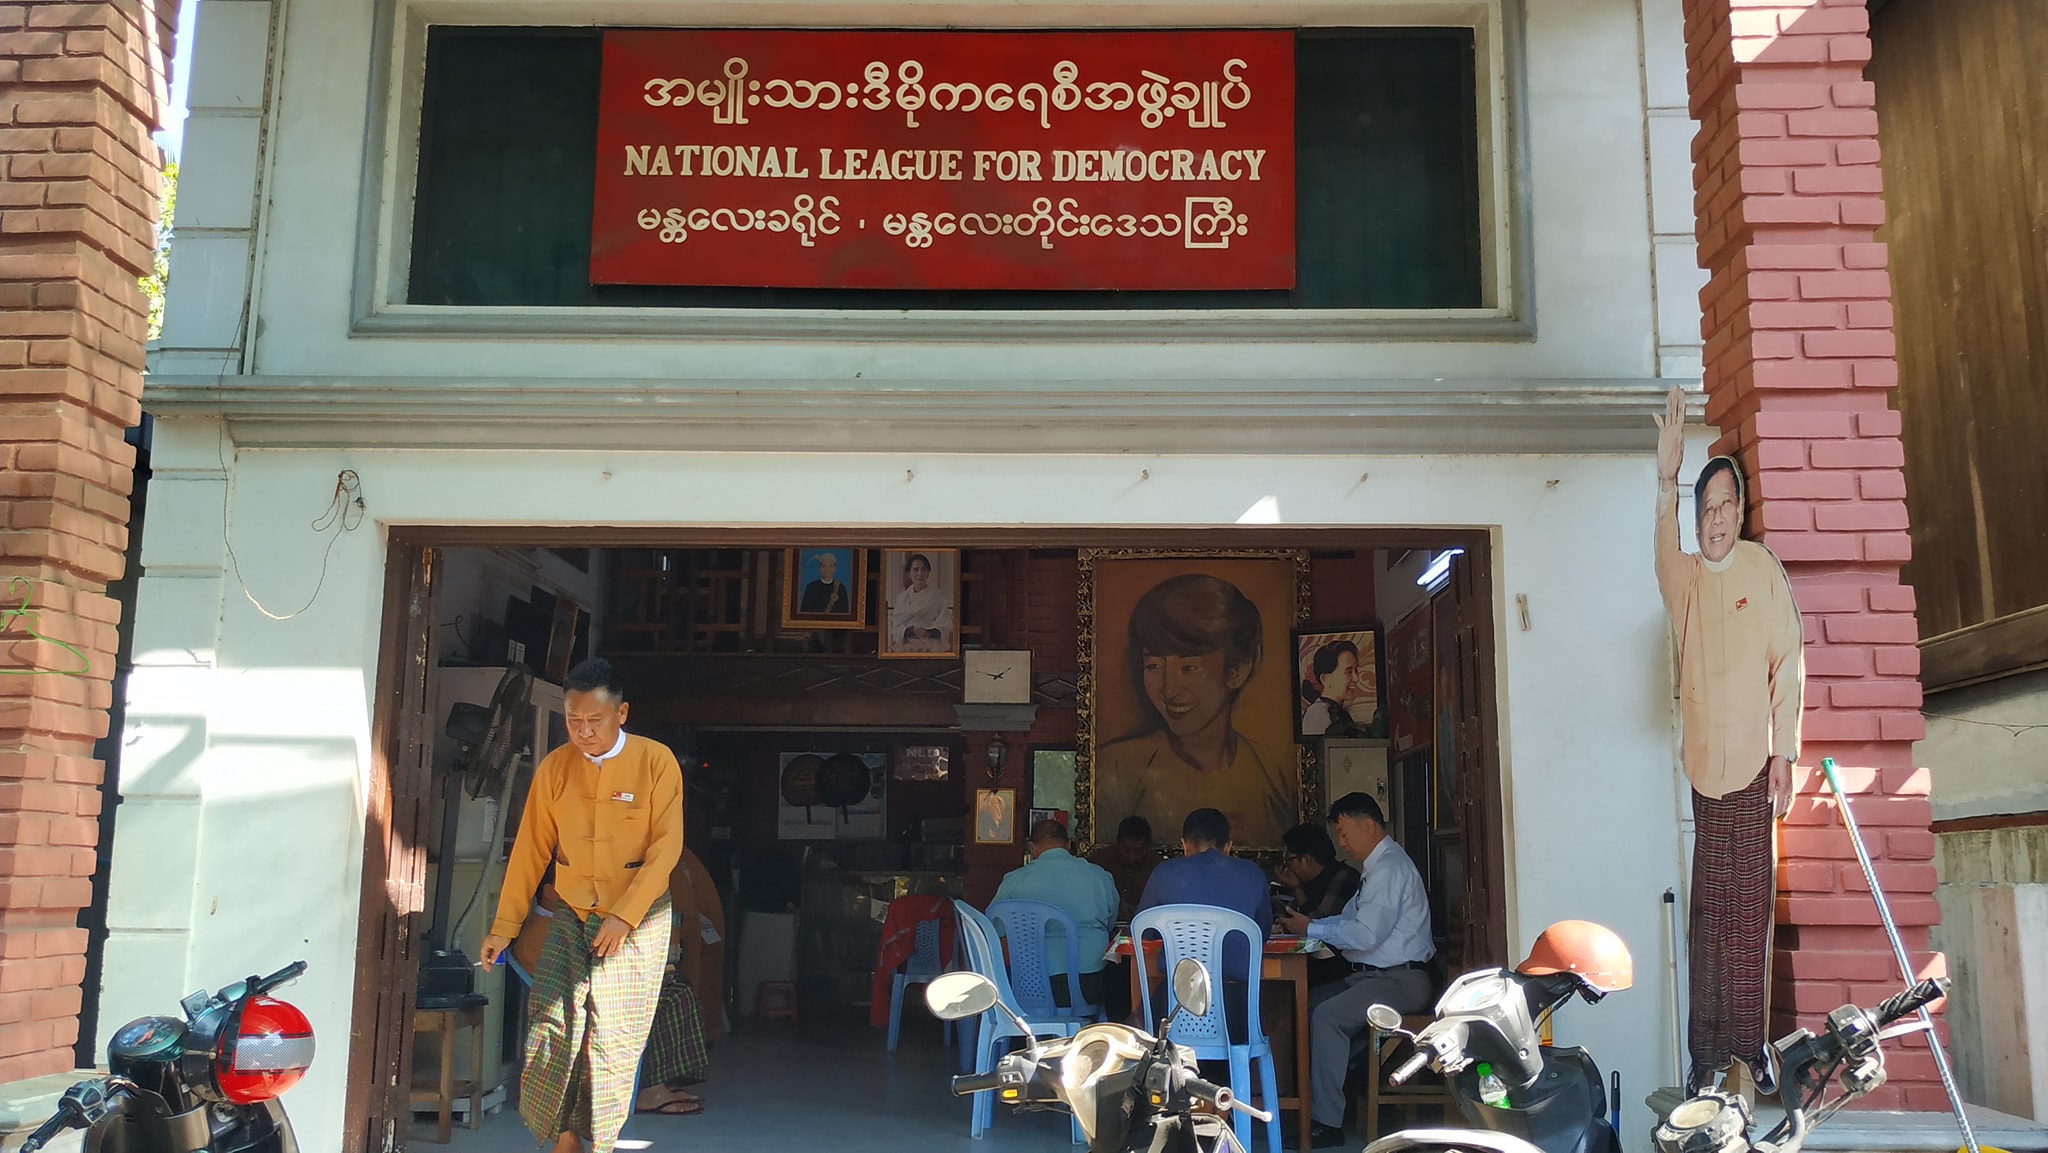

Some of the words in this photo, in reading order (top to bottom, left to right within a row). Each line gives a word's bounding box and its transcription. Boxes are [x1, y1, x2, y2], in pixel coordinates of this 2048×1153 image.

[623, 145, 809, 179] NATIONAL
[818, 148, 963, 181] LEAGUE
[972, 150, 1043, 182] FOR
[1051, 145, 1267, 182] DEMOCRACY
